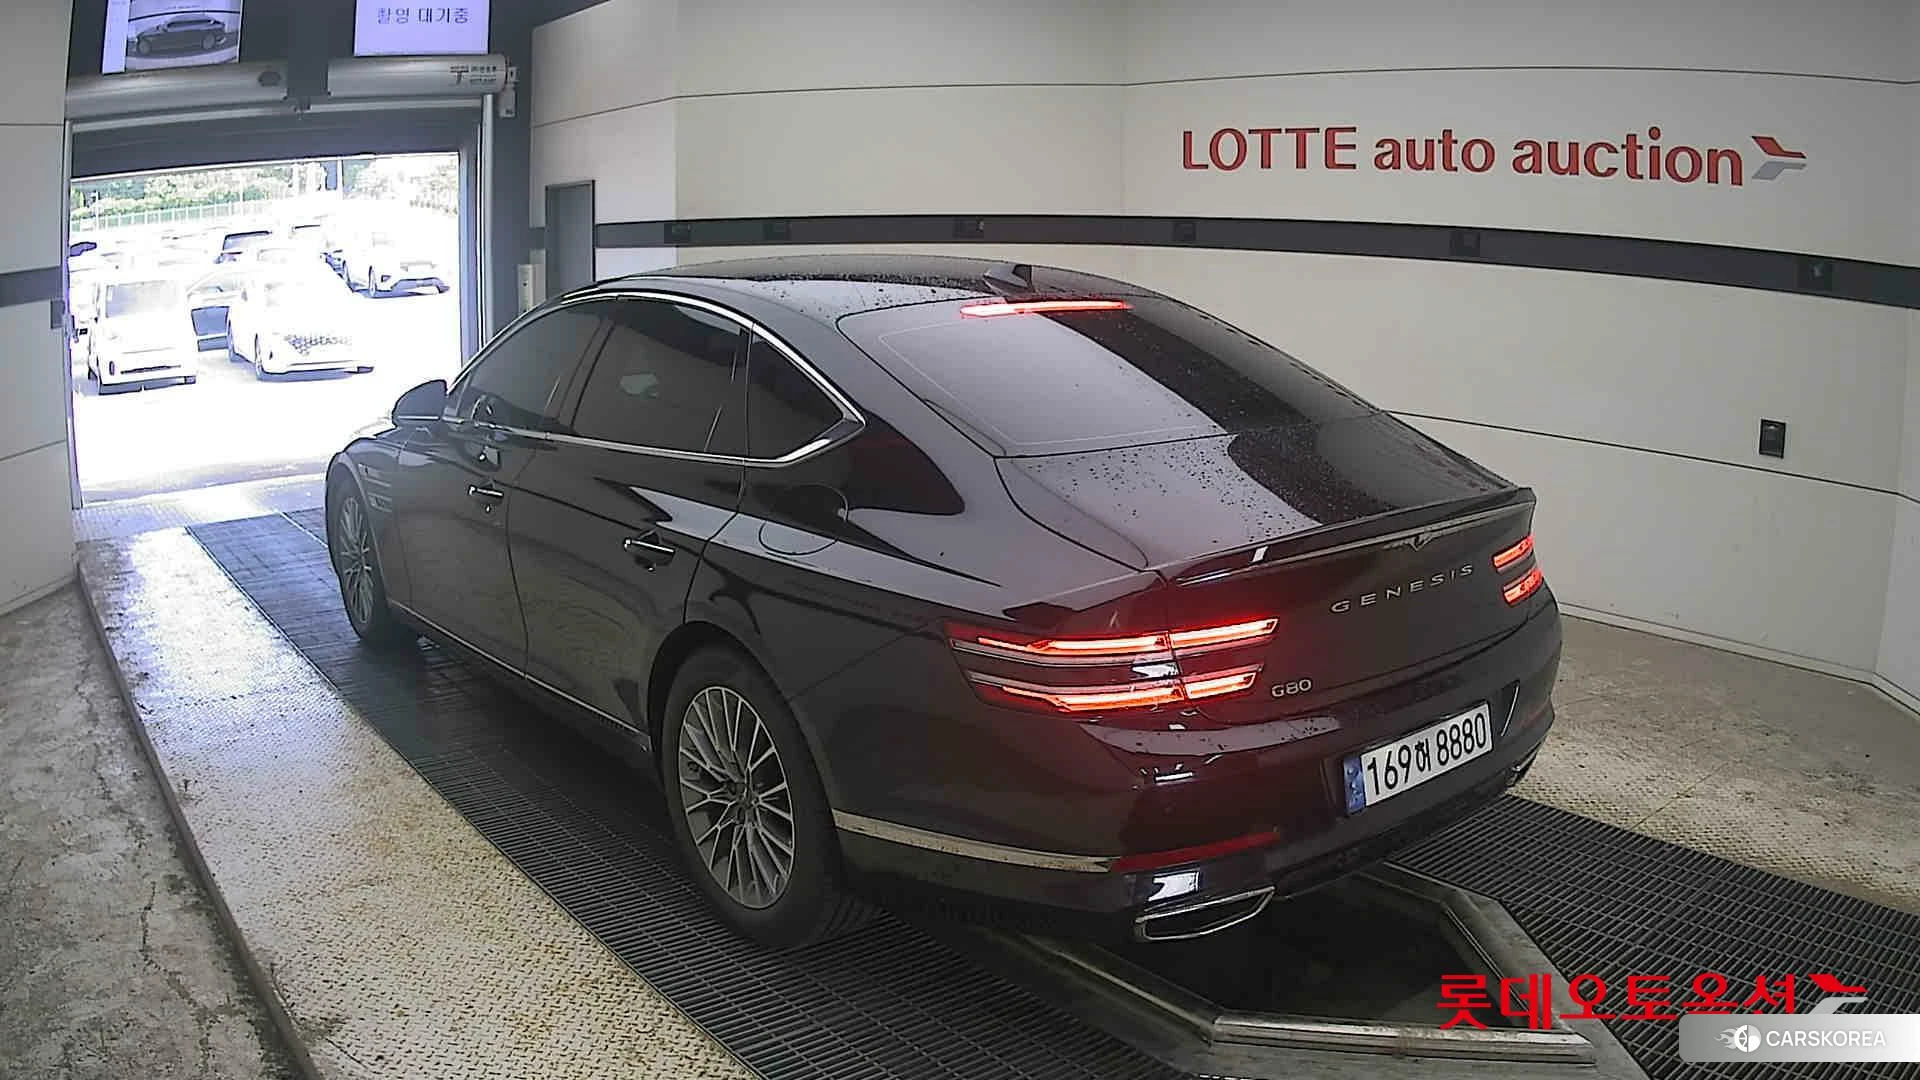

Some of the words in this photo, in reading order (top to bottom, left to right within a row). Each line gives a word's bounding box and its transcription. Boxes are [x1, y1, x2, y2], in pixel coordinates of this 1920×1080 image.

[418, 7, 471, 25] 대기중
[1182, 127, 1358, 171] LOTTE
[1374, 129, 1496, 174] auto
[1512, 126, 1744, 186] auction
[1330, 564, 1474, 613] GENESIS
[1271, 678, 1313, 698] G80
[1367, 737, 1432, 796] 169허
[1436, 713, 1487, 766] 8880
